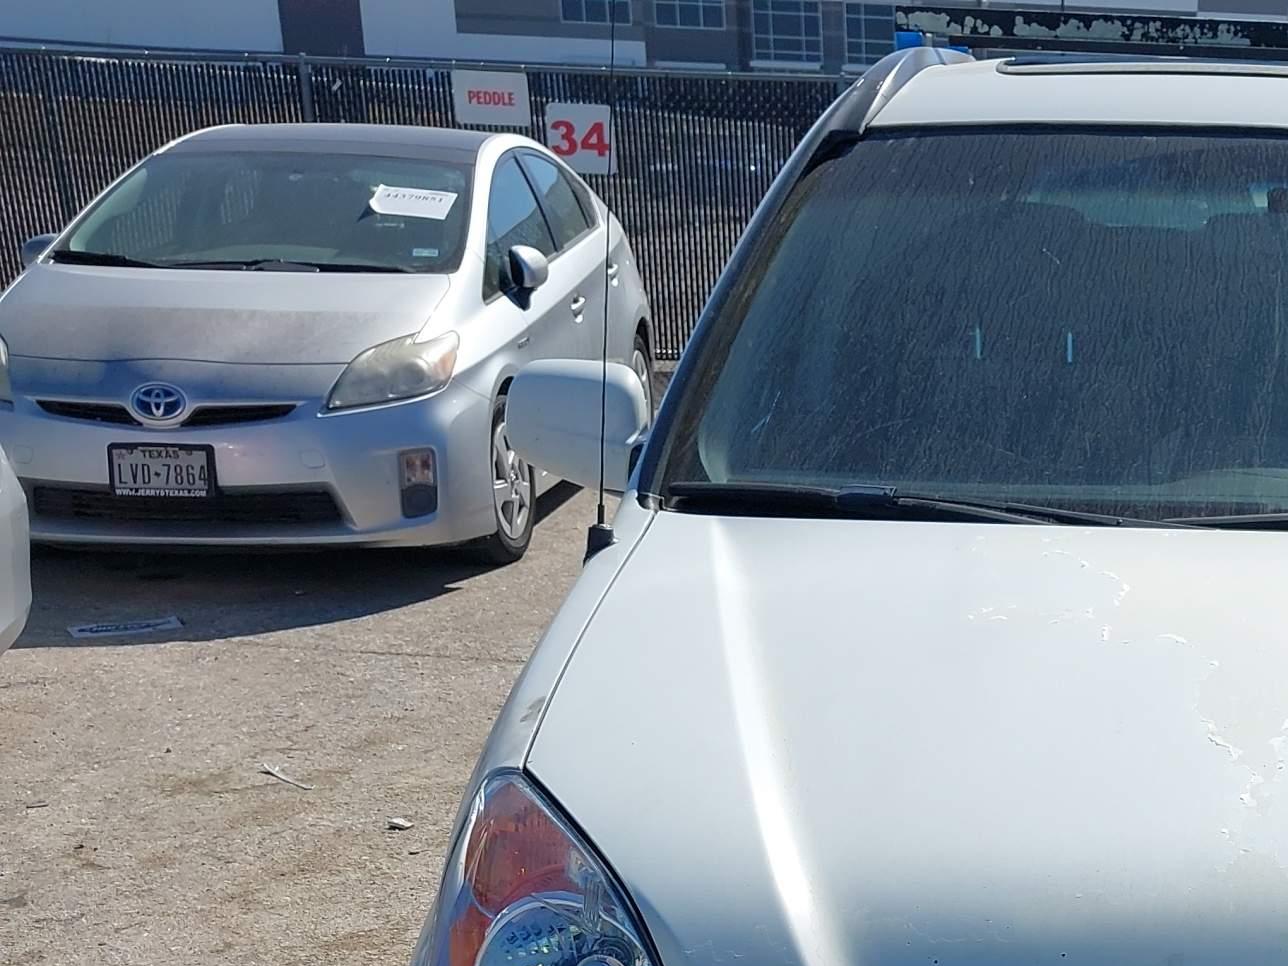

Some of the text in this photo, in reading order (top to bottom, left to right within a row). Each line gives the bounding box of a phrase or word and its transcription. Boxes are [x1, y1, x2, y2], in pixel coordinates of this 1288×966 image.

[467, 90, 515, 107] PEDDLE
[551, 120, 610, 157] 34
[141, 449, 180, 460] TEXAS
